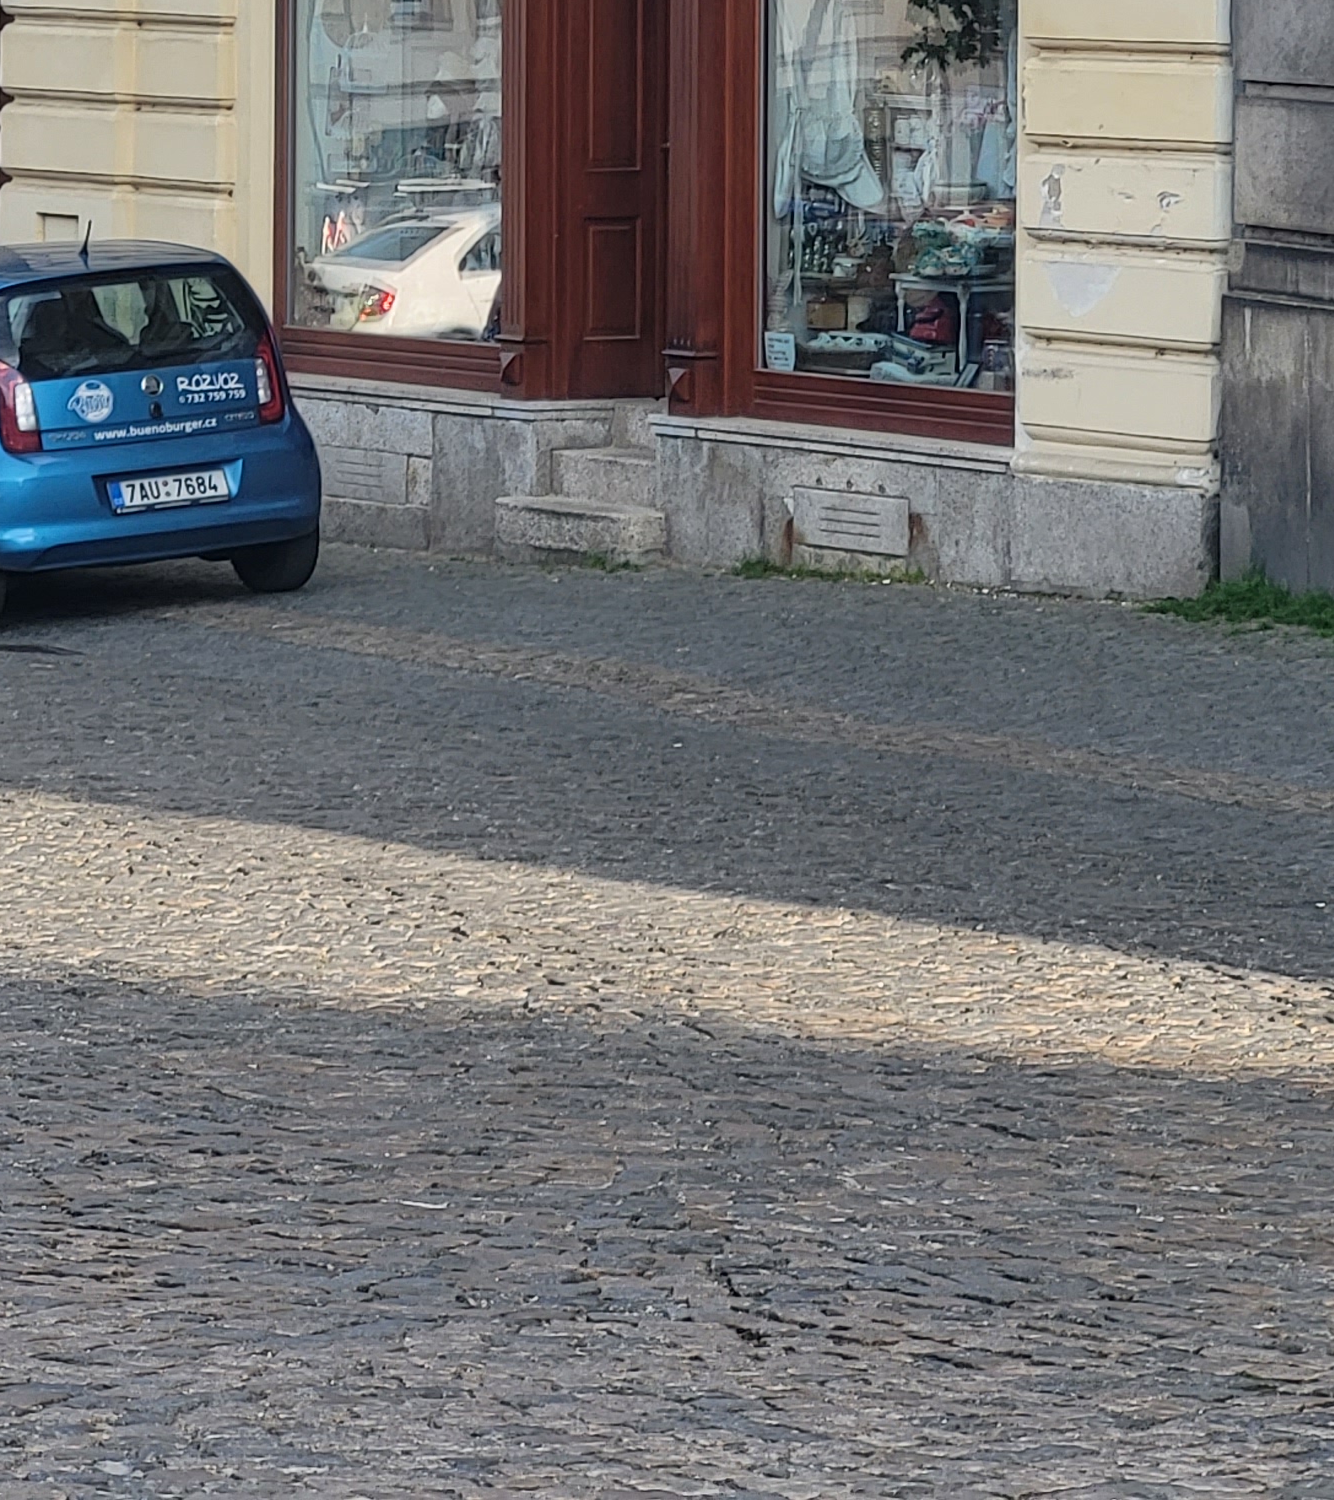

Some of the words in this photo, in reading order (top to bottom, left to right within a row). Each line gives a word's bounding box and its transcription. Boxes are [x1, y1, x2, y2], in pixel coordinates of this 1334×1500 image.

[176, 372, 245, 392] ROZVOZ
[186, 392, 205, 404] 732
[207, 390, 226, 402] 759
[228, 388, 246, 401] 759
[94, 416, 217, 441] www.buenoburger.cz
[126, 480, 161, 504] 7AU
[175, 474, 218, 498] 7684
